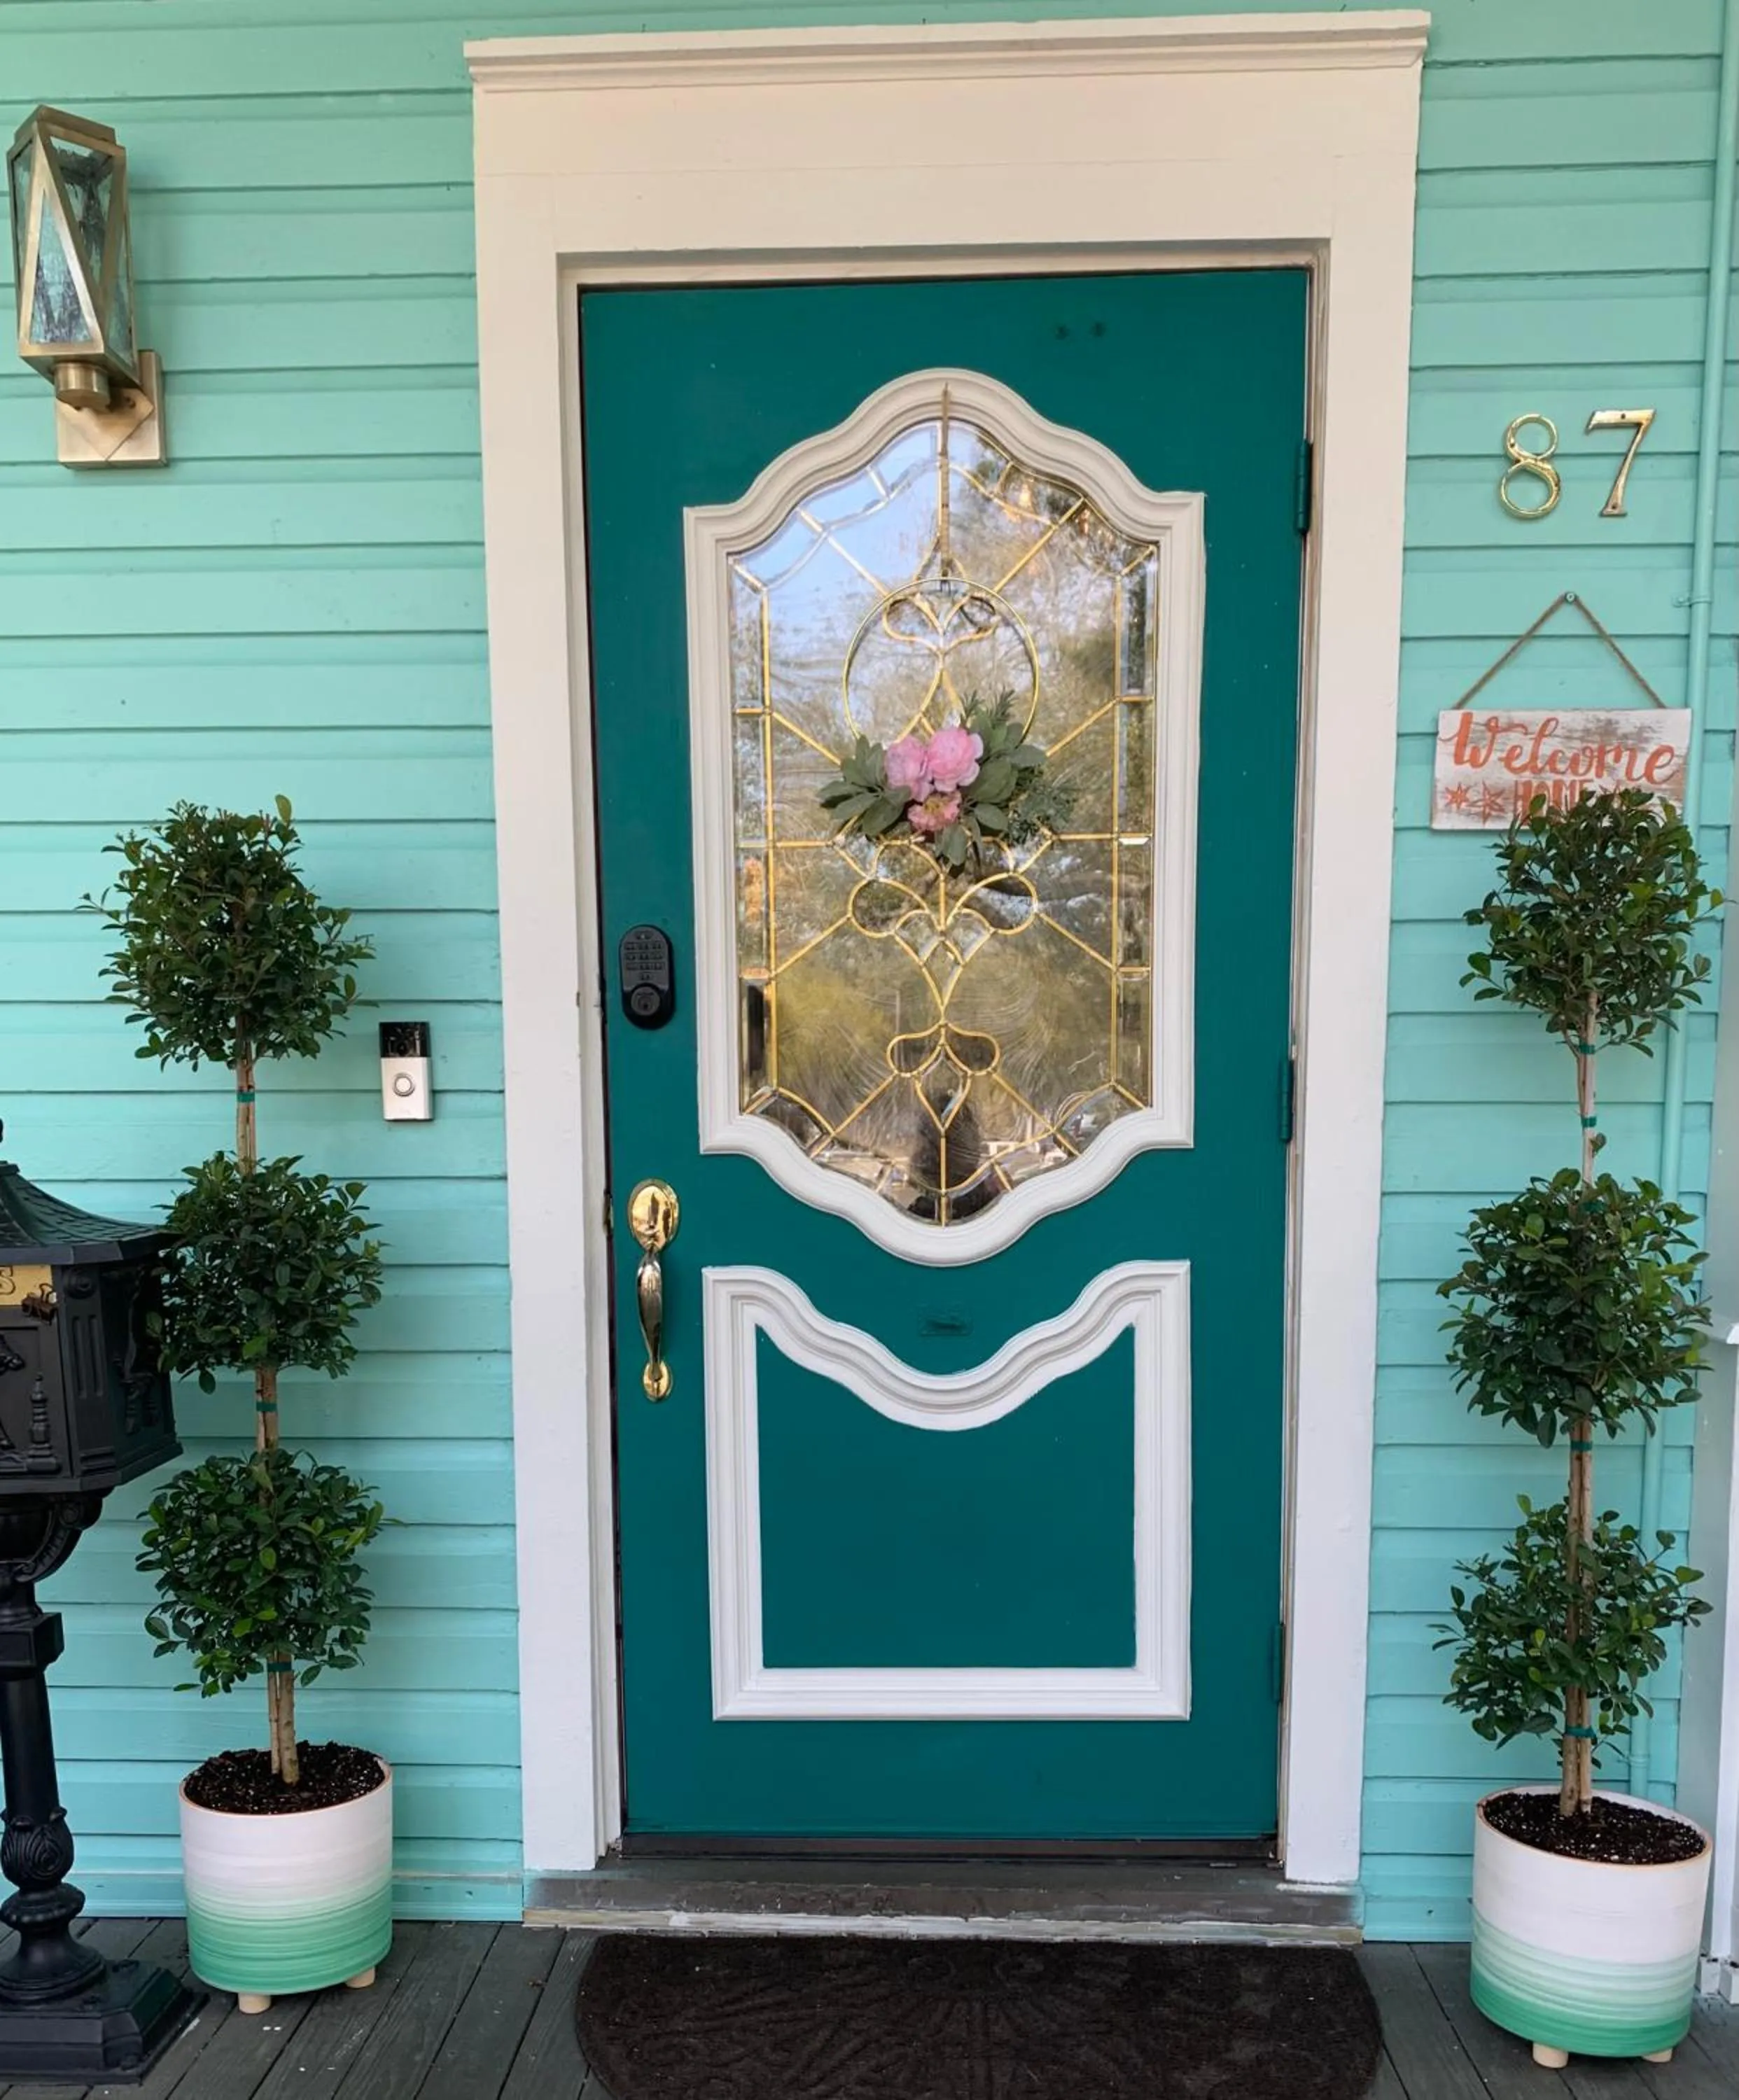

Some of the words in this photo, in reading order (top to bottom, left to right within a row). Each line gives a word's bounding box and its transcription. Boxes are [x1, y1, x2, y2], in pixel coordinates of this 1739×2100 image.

[1500, 408, 1656, 519] 87
[1438, 711, 1681, 785] Welcome
[1514, 779, 1595, 826] HOM
